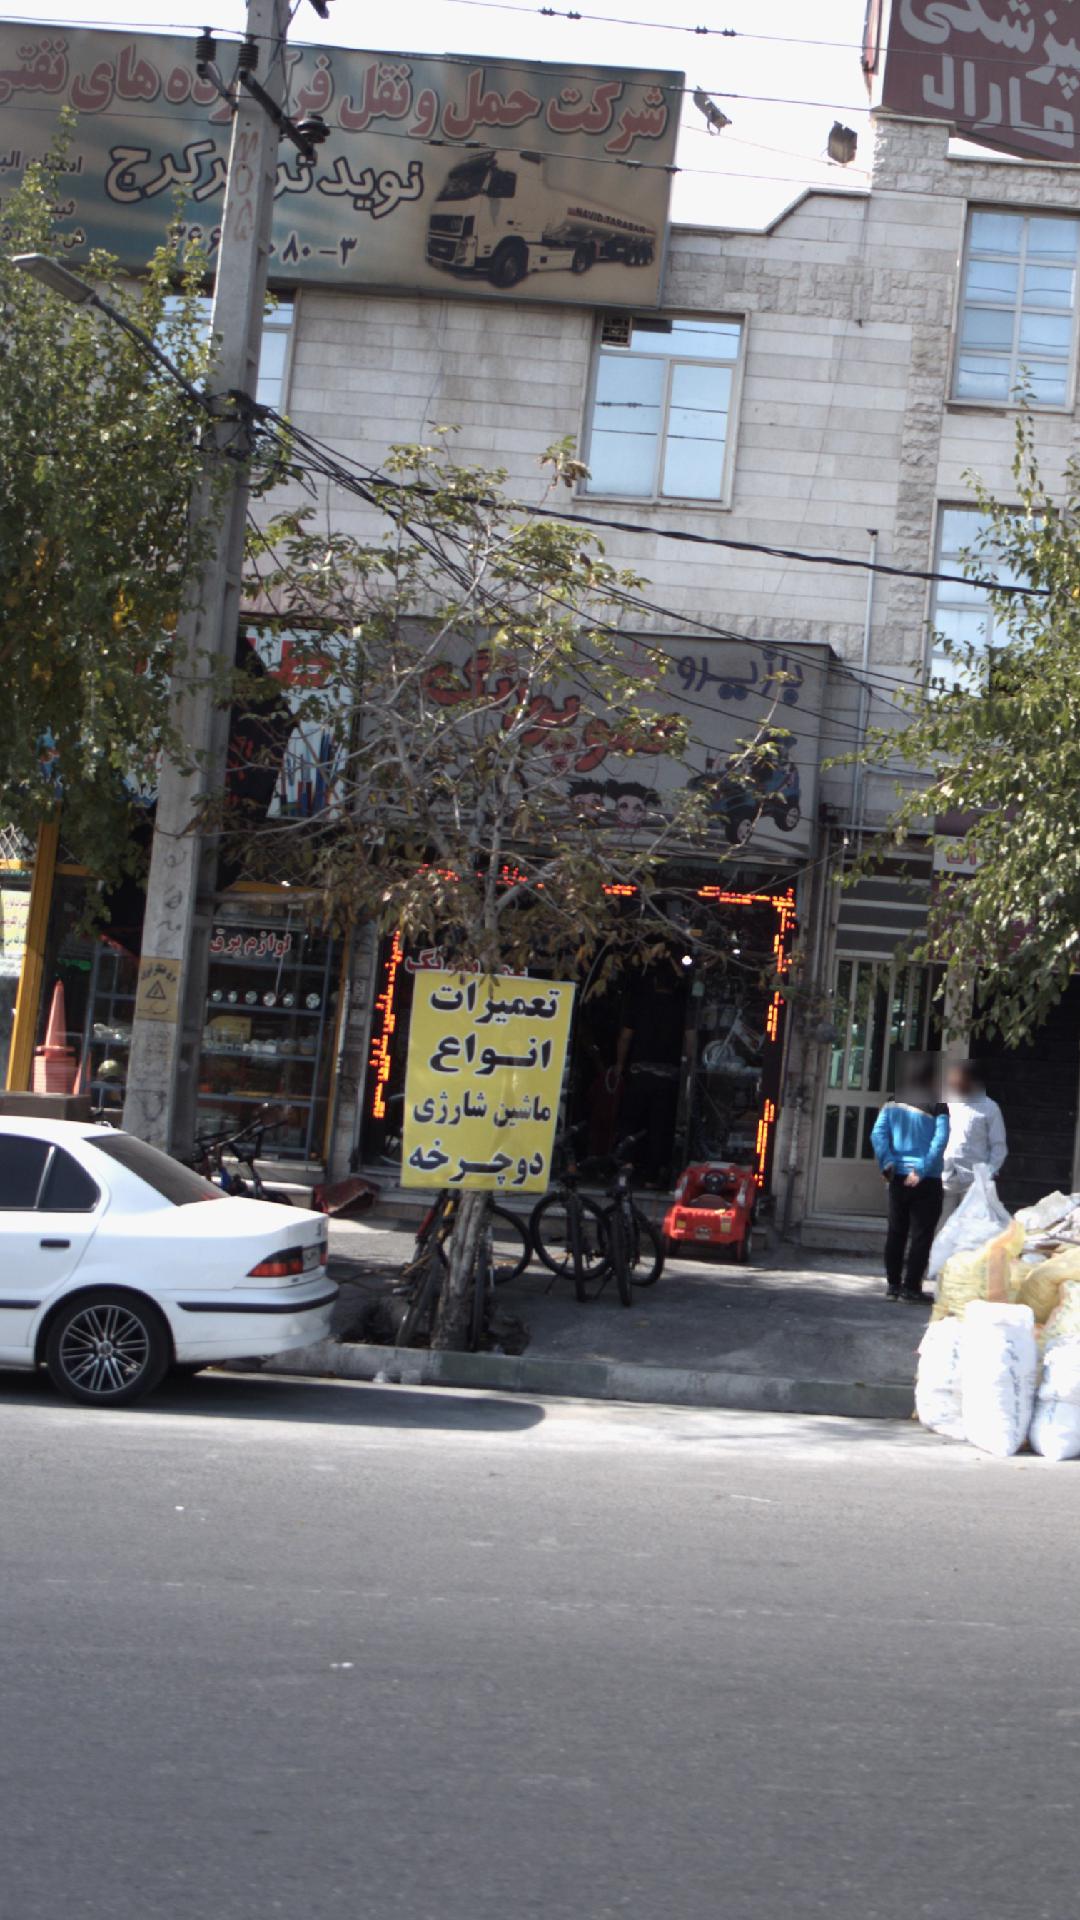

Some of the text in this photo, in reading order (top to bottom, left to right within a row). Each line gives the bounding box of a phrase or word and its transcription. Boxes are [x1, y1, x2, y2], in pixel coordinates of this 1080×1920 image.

[69, 43, 160, 111] های
[338, 62, 413, 131] نقل
[922, 53, 1075, 149] مارال
[408, 87, 439, 137] و
[441, 68, 540, 138] حمل
[546, 81, 668, 152] شرکت
[0, 151, 21, 173] الب
[105, 138, 216, 204] کرج
[193, 152, 317, 201] ترر
[317, 156, 425, 220] نوید
[243, 929, 293, 959] لوازم
[430, 980, 560, 1024] تعمیرات
[429, 1032, 552, 1075] انواع
[413, 1090, 487, 1125] شارژی
[493, 1095, 551, 1127] ماشین
[409, 1139, 544, 1185] دوچرخه
